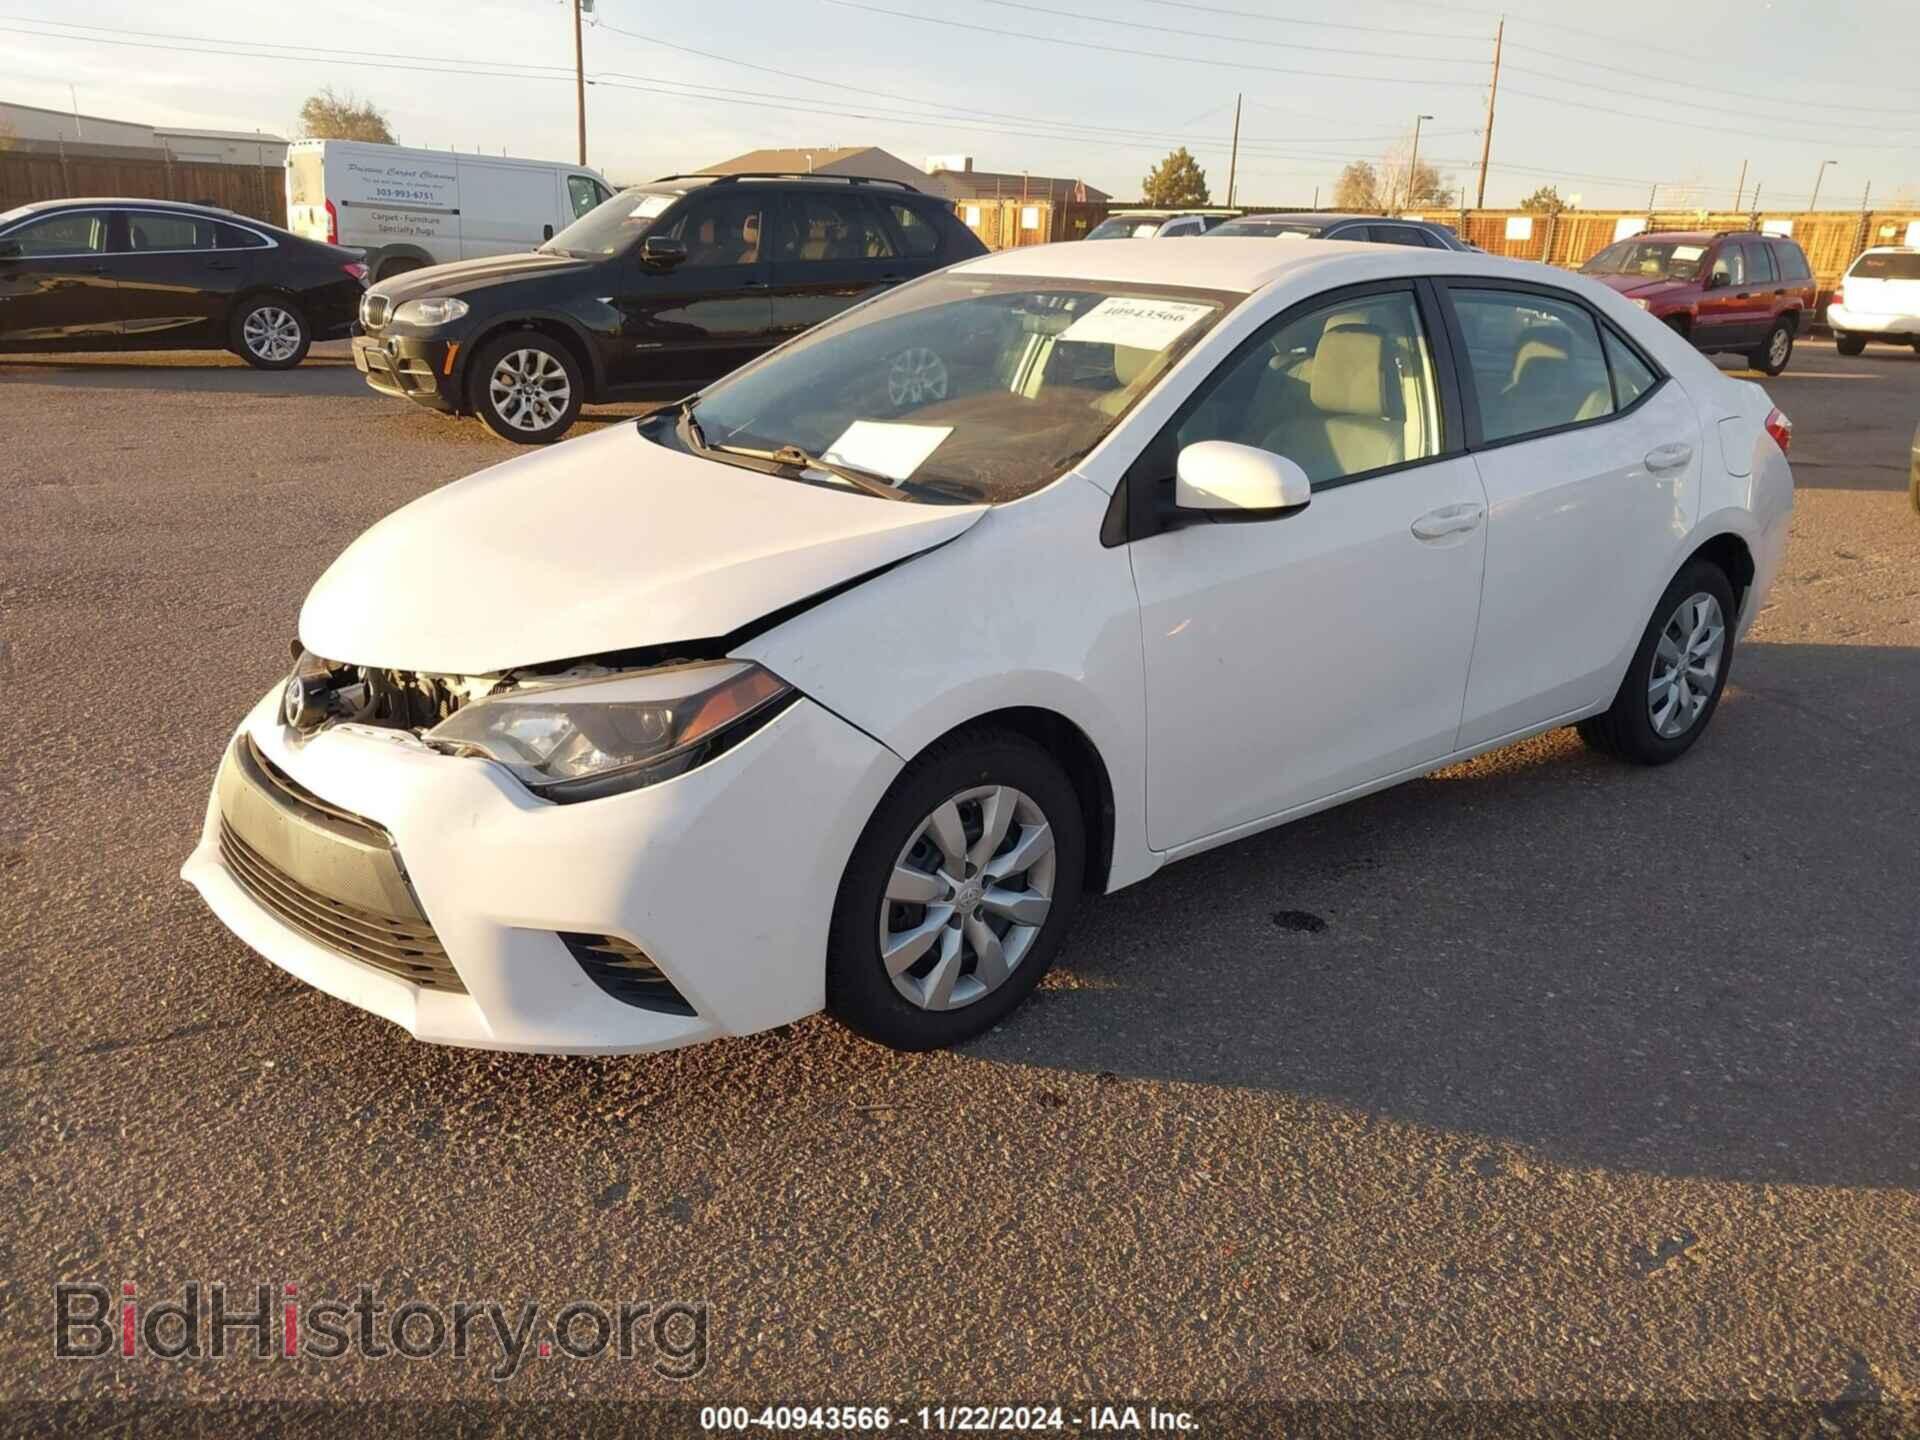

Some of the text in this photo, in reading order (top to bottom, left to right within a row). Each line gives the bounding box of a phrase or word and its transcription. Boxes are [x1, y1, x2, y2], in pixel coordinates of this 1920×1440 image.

[371, 211, 398, 224] Carpet
[404, 214, 440, 224] Furniture
[378, 223, 414, 235] Specialty
